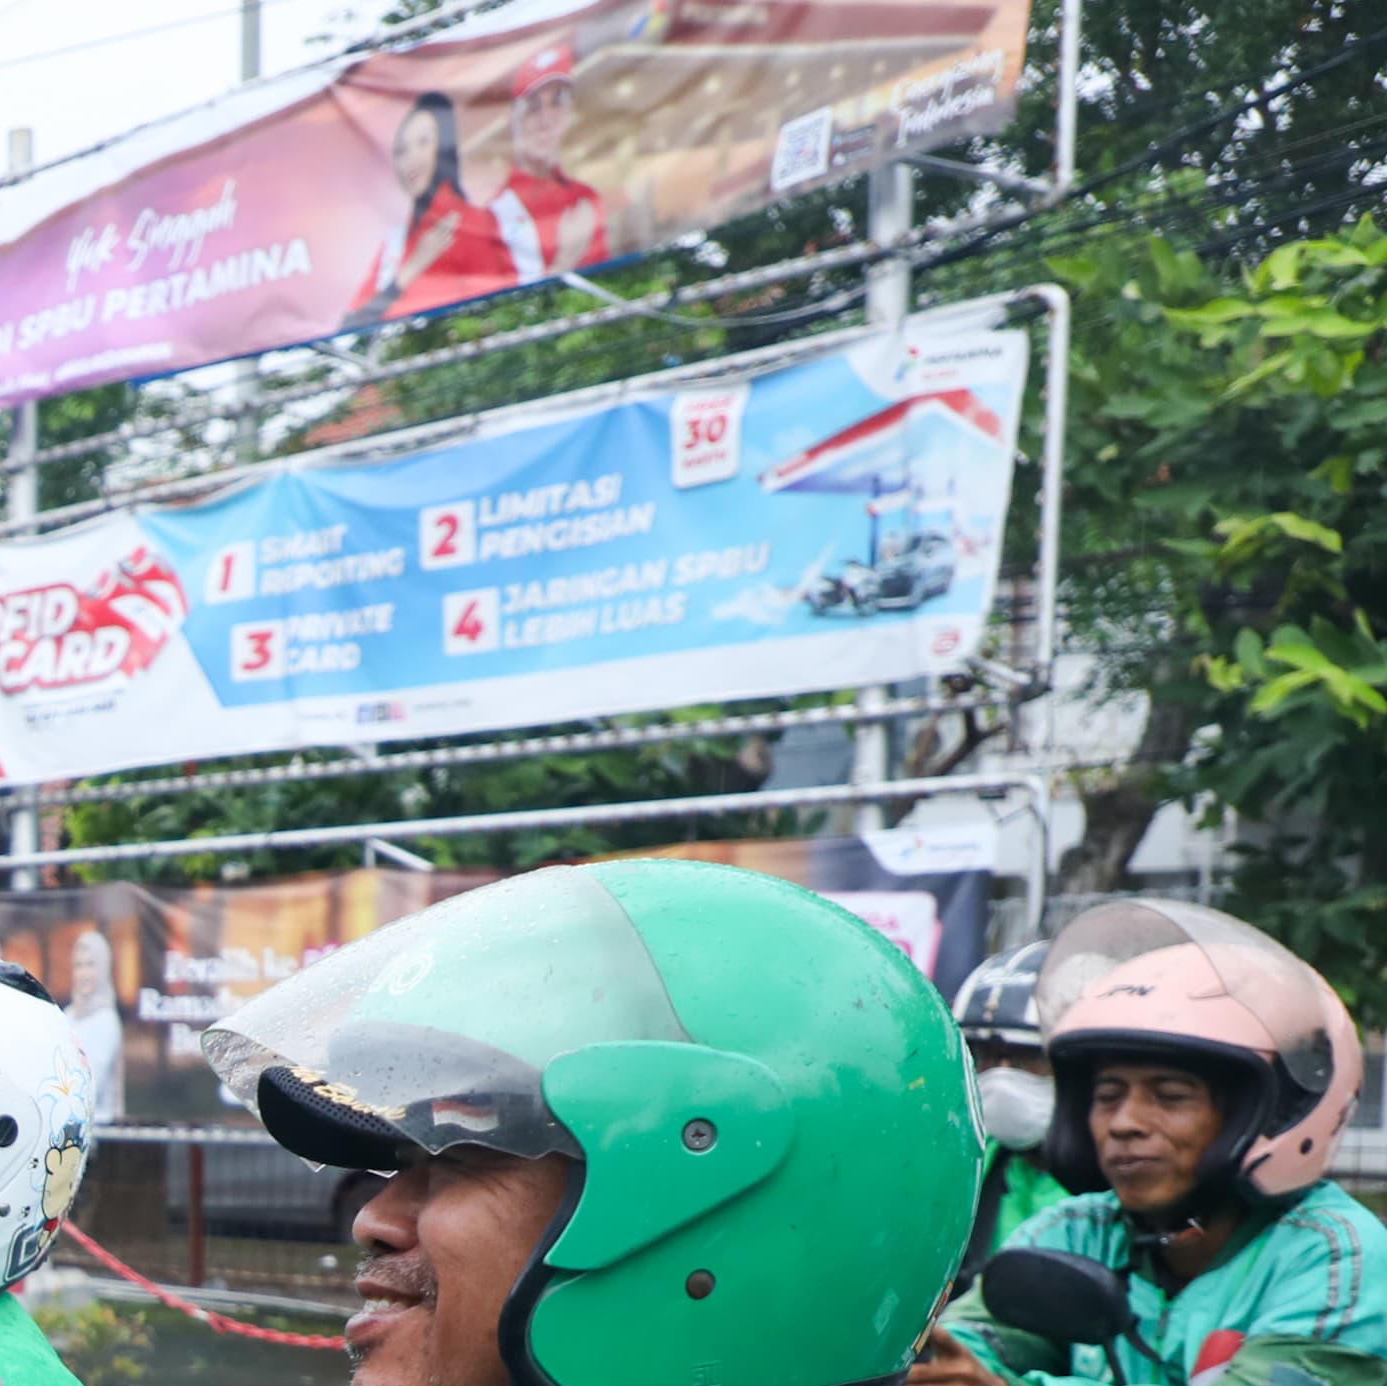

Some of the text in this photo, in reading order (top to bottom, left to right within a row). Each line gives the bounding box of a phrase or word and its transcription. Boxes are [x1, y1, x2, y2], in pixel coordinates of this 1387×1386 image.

[17, 293, 97, 352] SPBU
[100, 237, 314, 324] PERTAMINA
[683, 414, 728, 450] 30
[431, 472, 624, 558] 2 LIMITASI
[478, 502, 656, 561] PENGISIAN
[219, 553, 237, 592] 1
[452, 541, 772, 643] 4 JARINGAN SPBU
[504, 592, 689, 649] LEBIH LUAS
[241, 630, 275, 672] 3
